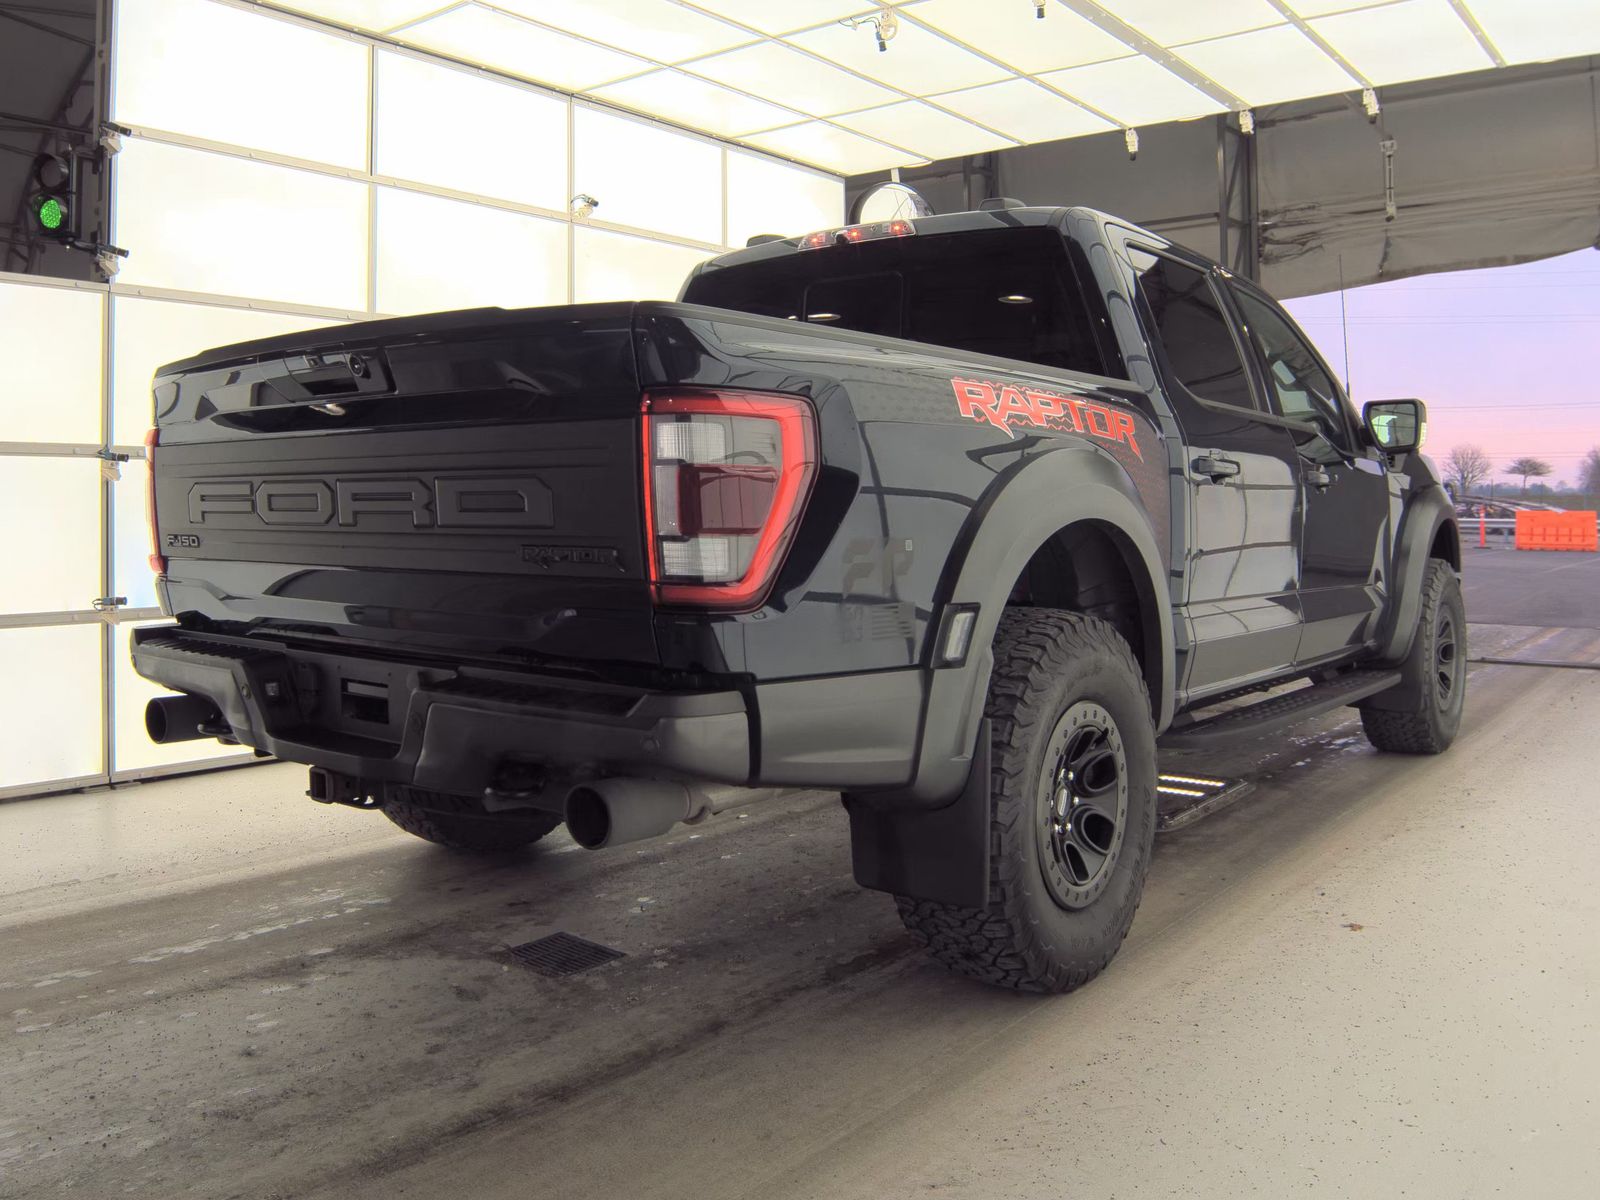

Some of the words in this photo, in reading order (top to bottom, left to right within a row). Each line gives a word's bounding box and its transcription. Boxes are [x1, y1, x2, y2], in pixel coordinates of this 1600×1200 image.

[951, 379, 1144, 464] RAPTOR
[187, 476, 555, 530] FORD
[166, 534, 200, 548] F-150
[520, 544, 626, 573] RAPTOR
